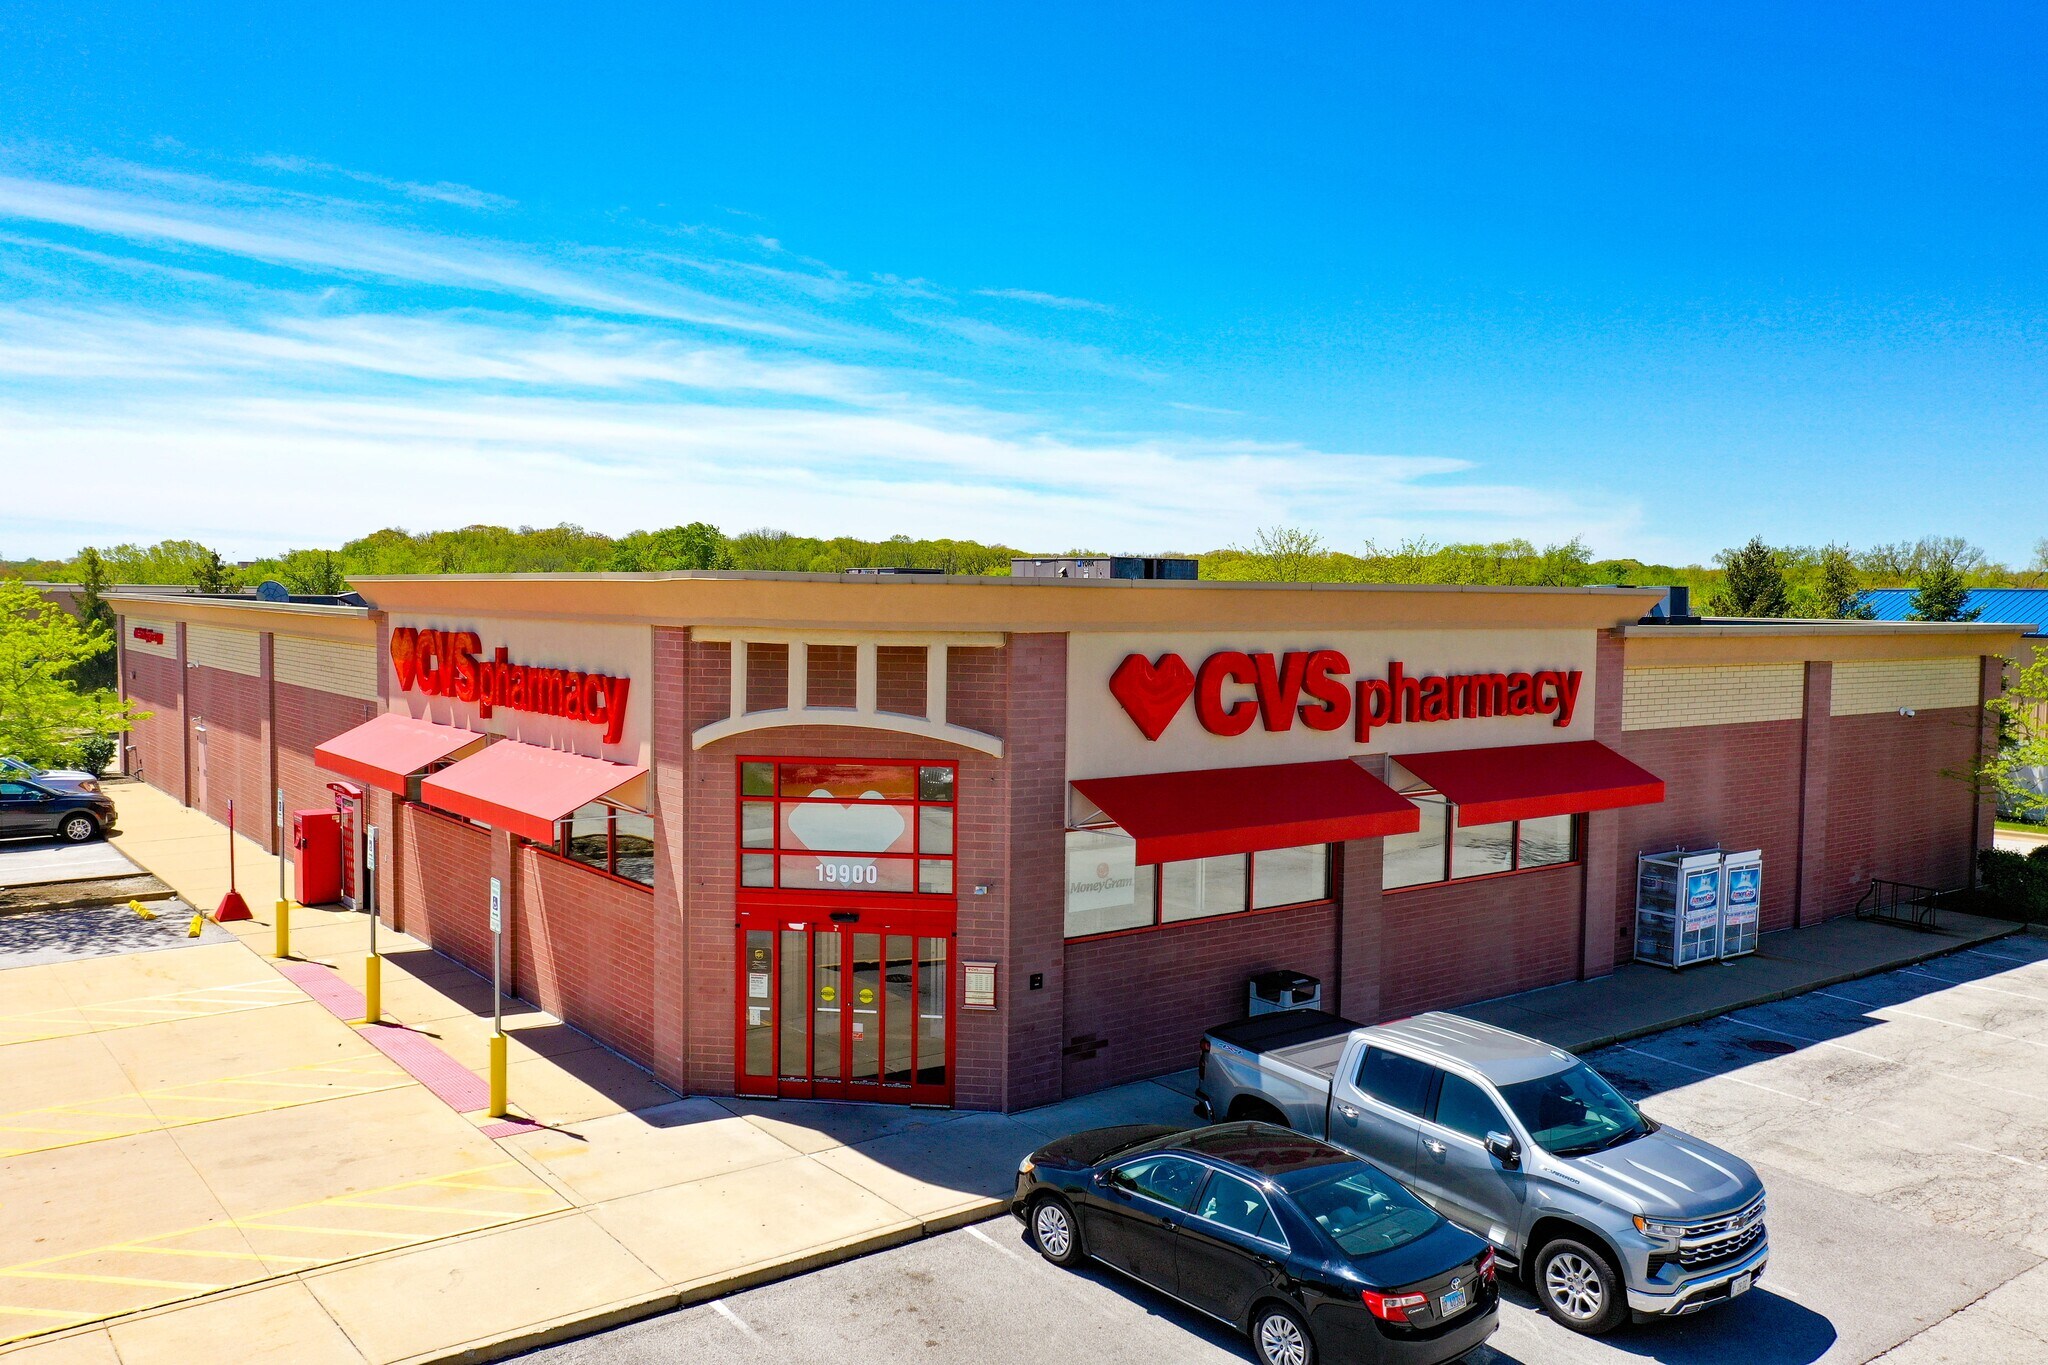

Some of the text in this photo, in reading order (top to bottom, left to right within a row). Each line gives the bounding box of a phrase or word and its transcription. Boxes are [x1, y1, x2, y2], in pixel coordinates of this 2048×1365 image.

[416, 628, 632, 744] CVS pharmacy
[1194, 650, 1583, 743] CVS pharmacy
[815, 863, 877, 884] 19900
[1070, 878, 1133, 894] MoneyGram
